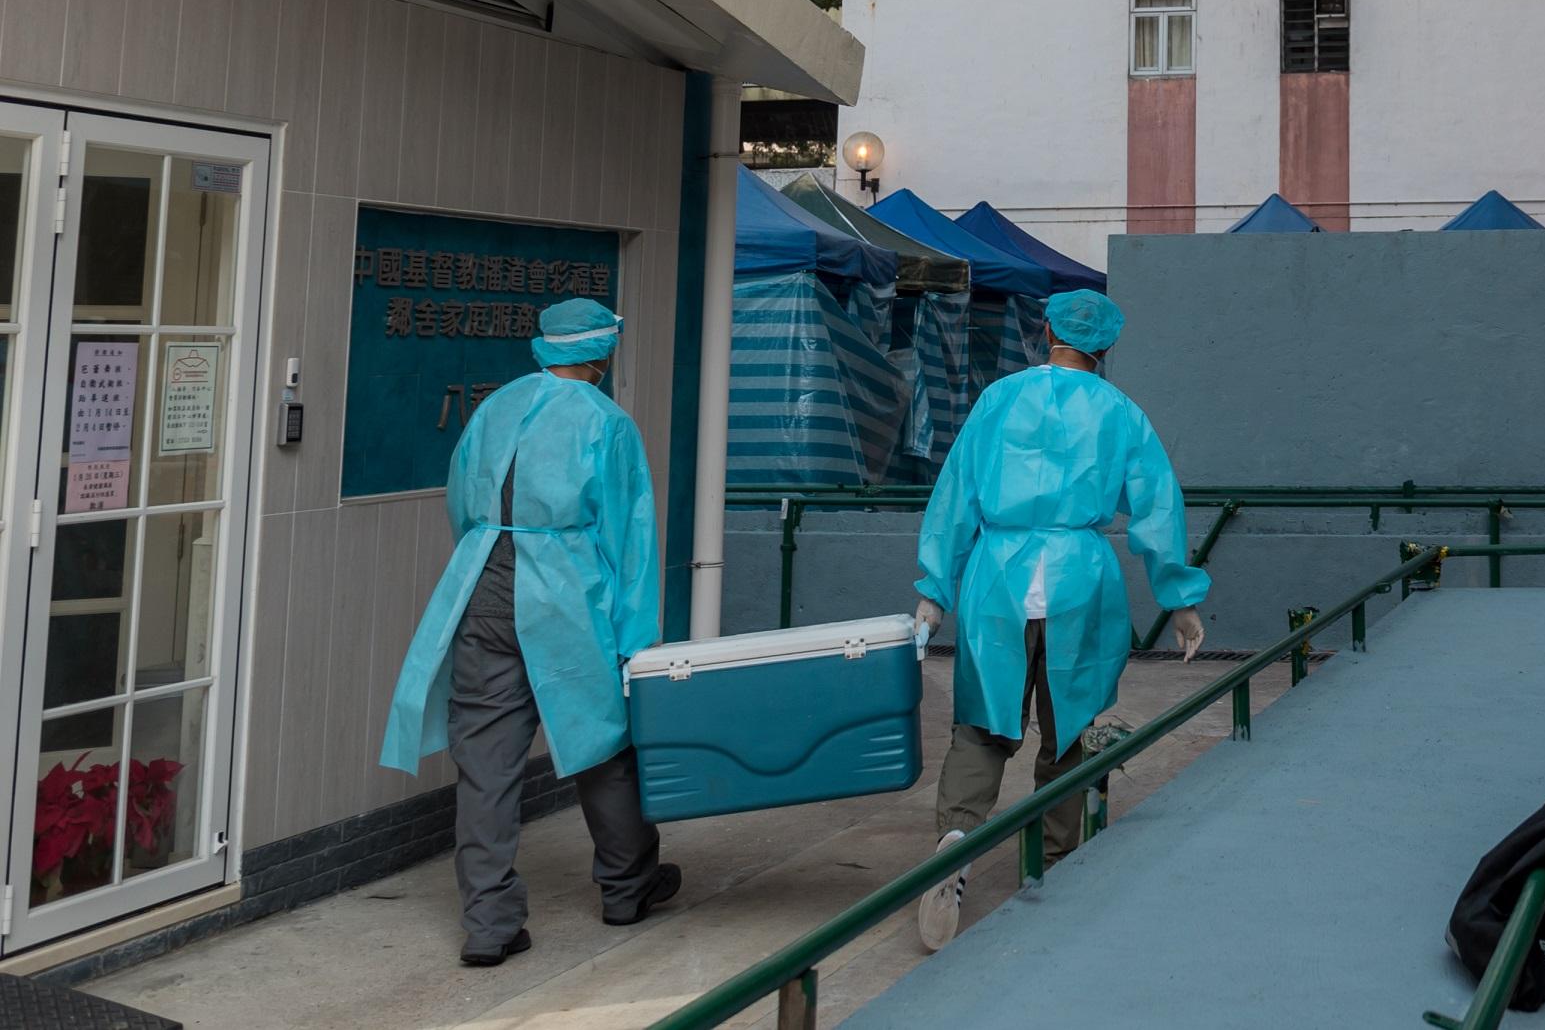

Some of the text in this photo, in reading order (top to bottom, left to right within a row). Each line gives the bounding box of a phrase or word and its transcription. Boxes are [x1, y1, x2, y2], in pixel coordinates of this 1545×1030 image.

[354, 246, 609, 297] 中國基督教播道會彩福堂
[385, 296, 548, 338] 鄰舍家庭服務
